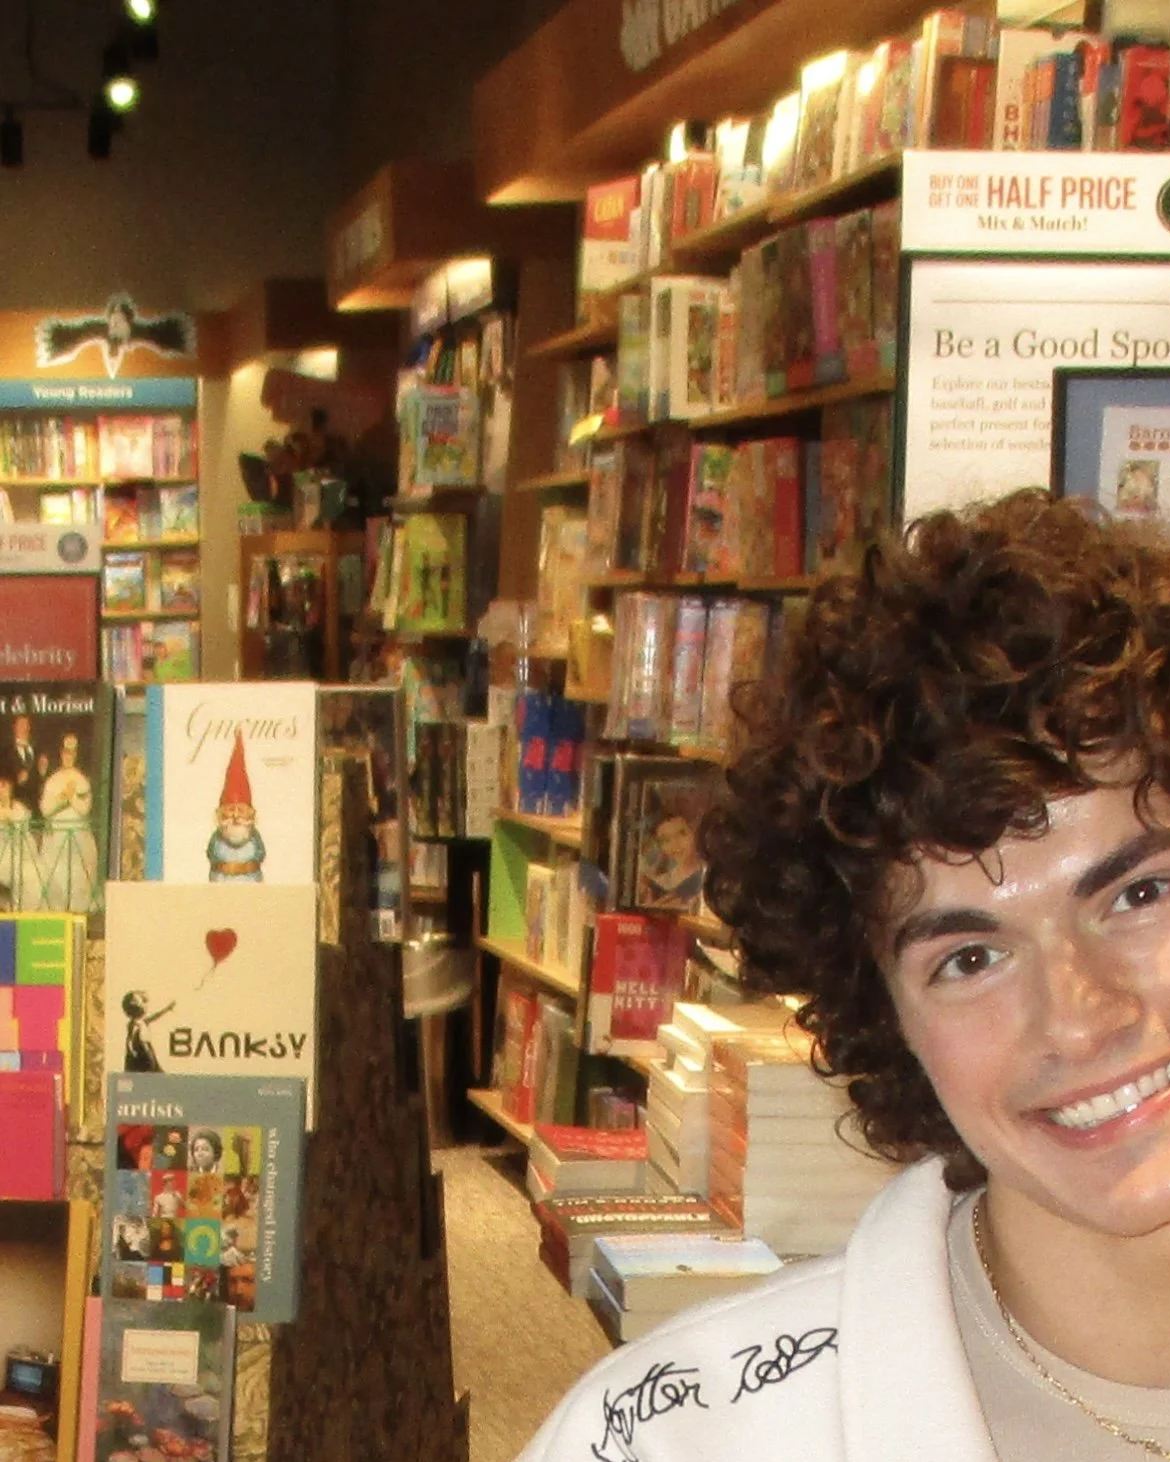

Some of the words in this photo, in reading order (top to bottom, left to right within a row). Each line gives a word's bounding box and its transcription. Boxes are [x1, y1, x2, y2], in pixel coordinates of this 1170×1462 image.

[987, 175, 1054, 209] HALF
[1061, 176, 1138, 210] PRICE
[977, 214, 1008, 231] Mix
[1030, 215, 1089, 232] Match!
[934, 329, 974, 359] Be
[984, 335, 1001, 359] a
[1012, 328, 1099, 360] Good
[32, 692, 95, 713] Morisot
[185, 701, 299, 765] Gnomes
[116, 1100, 185, 1118] artists
